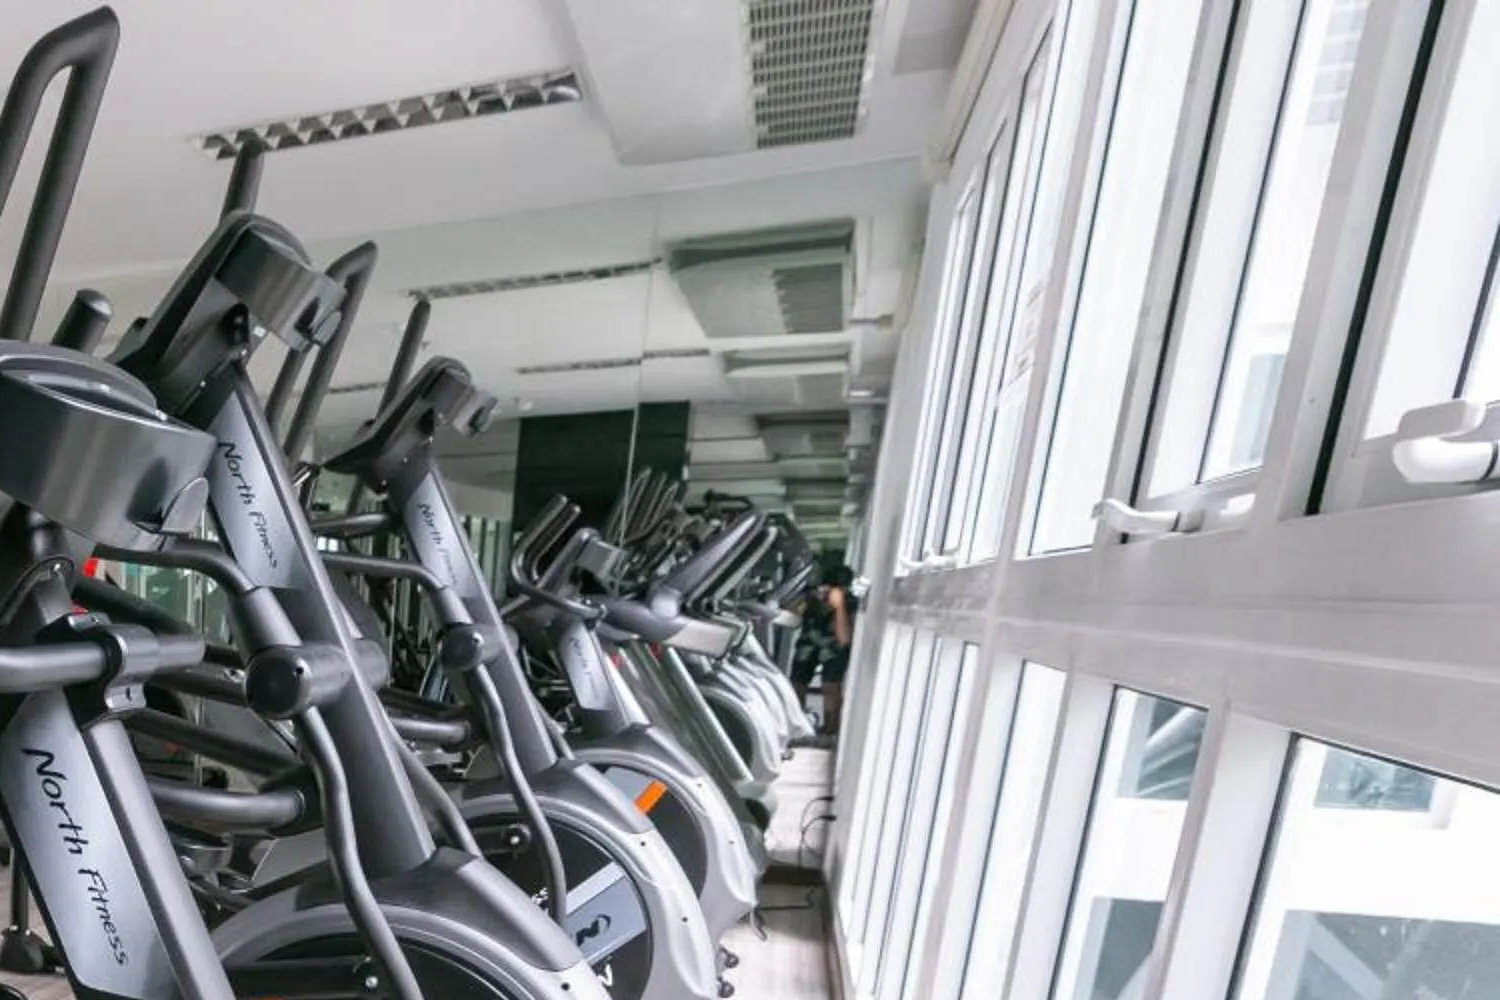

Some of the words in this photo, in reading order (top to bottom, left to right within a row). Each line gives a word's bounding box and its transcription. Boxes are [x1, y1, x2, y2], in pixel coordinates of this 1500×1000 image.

[217, 441, 256, 505] North
[22, 747, 89, 855] North
[77, 868, 129, 967] Fitness
